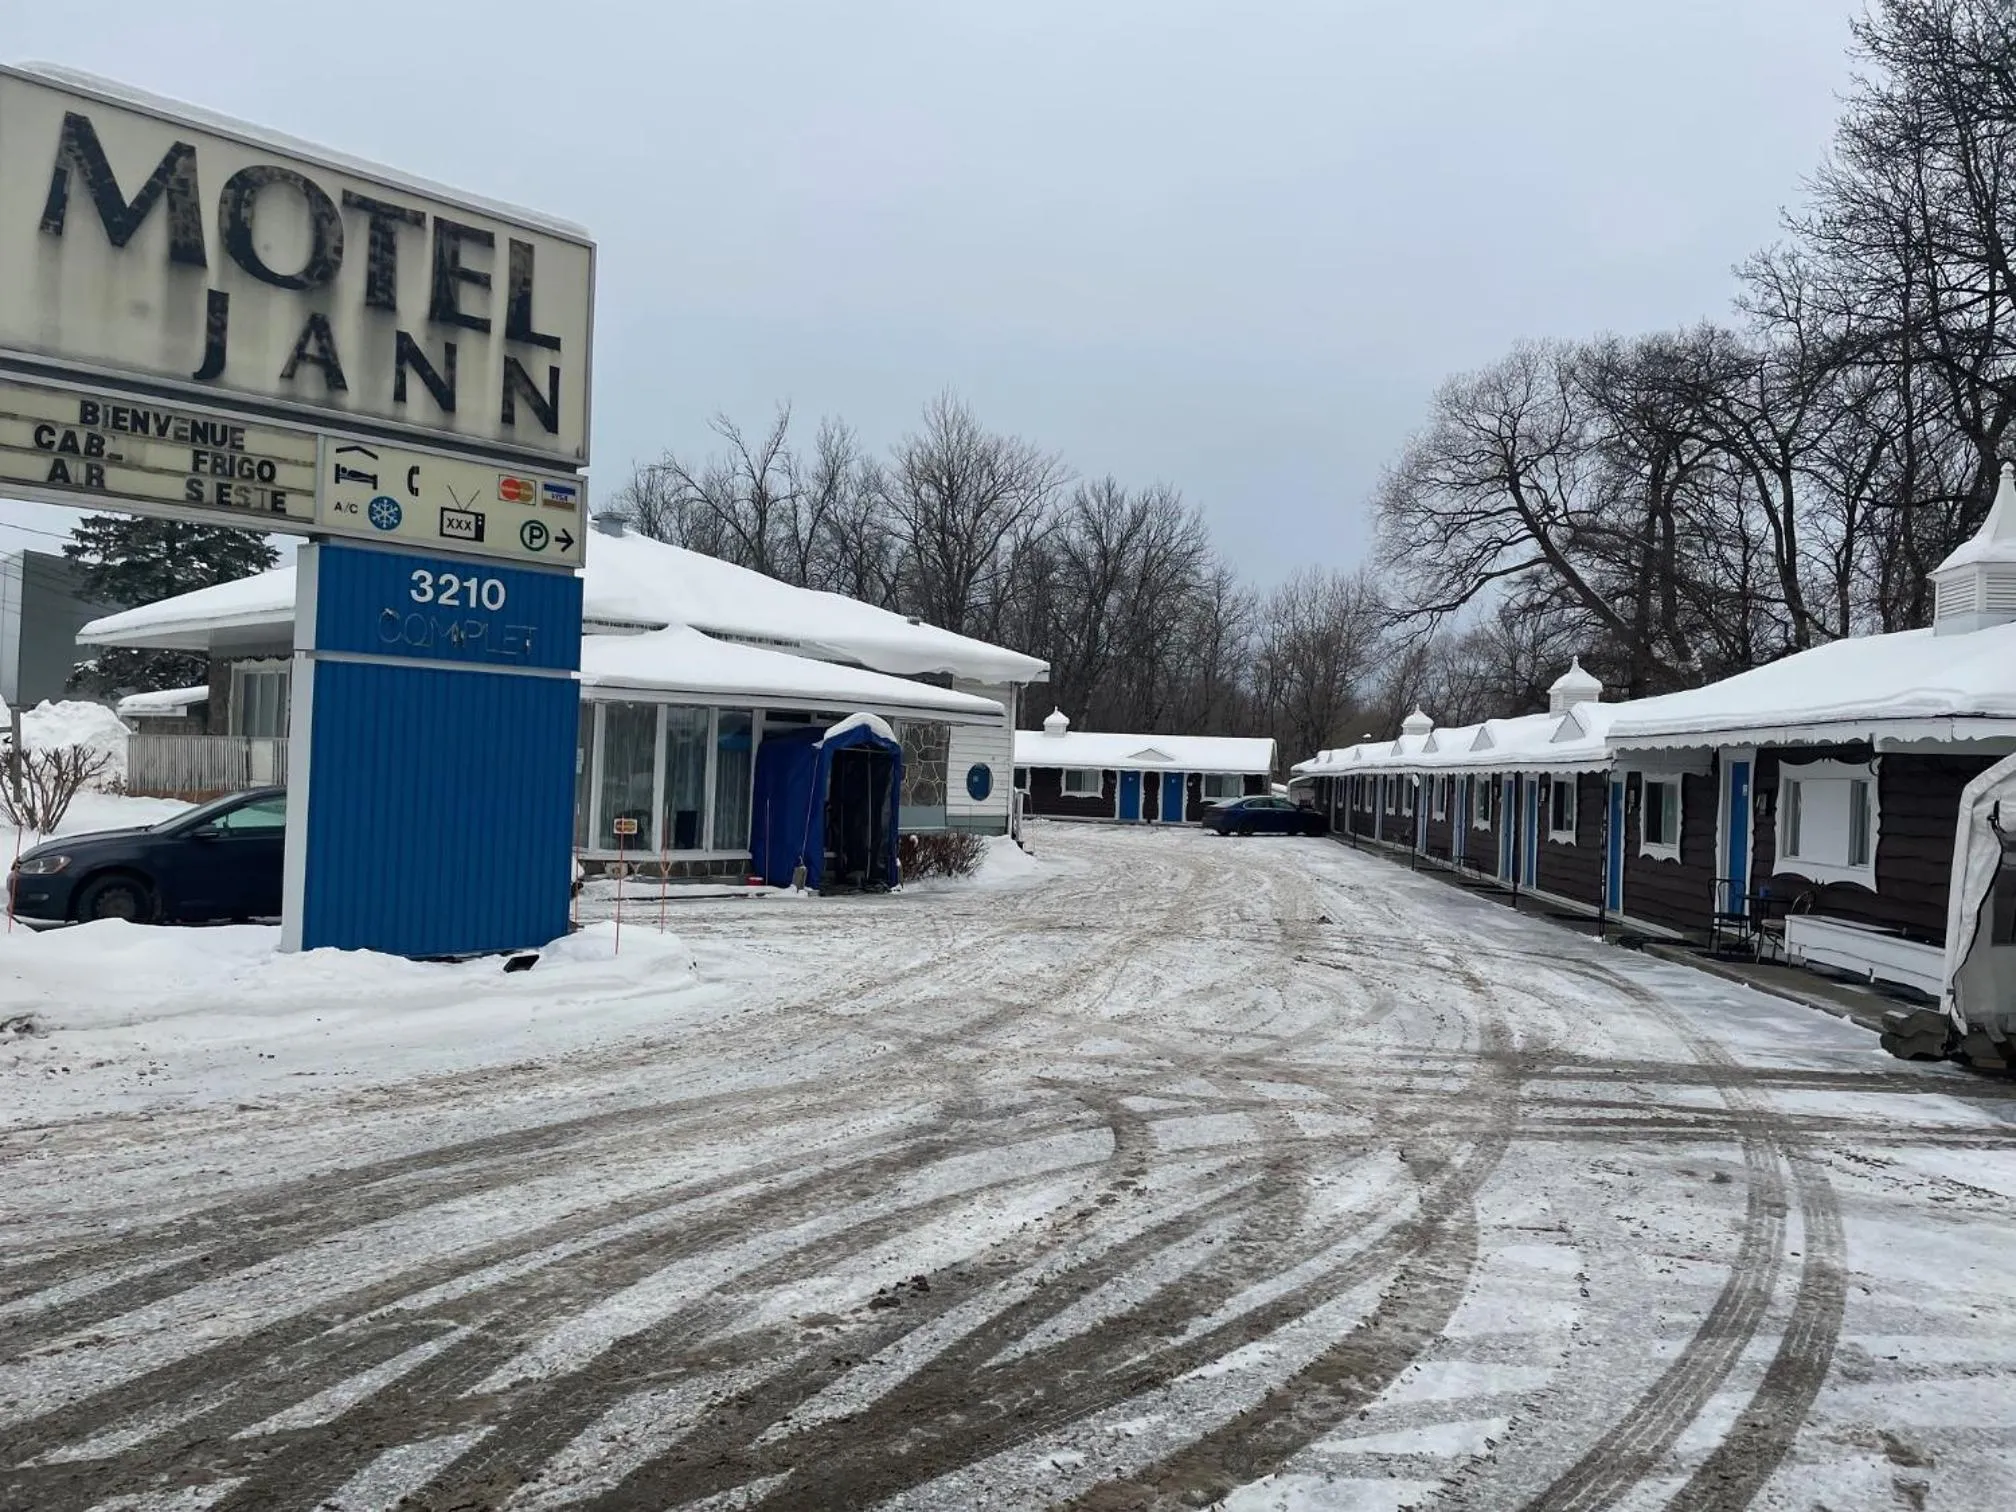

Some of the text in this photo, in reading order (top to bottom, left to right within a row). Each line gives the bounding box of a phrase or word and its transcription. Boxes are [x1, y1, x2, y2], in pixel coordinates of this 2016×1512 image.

[39, 111, 561, 351] MOTEL
[193, 289, 560, 435] JANN
[80, 400, 245, 450] BIENVENUE
[192, 449, 276, 482] FRIGO
[334, 502, 359, 515] A/C
[446, 517, 473, 532] XXX
[410, 569, 506, 611] 3210
